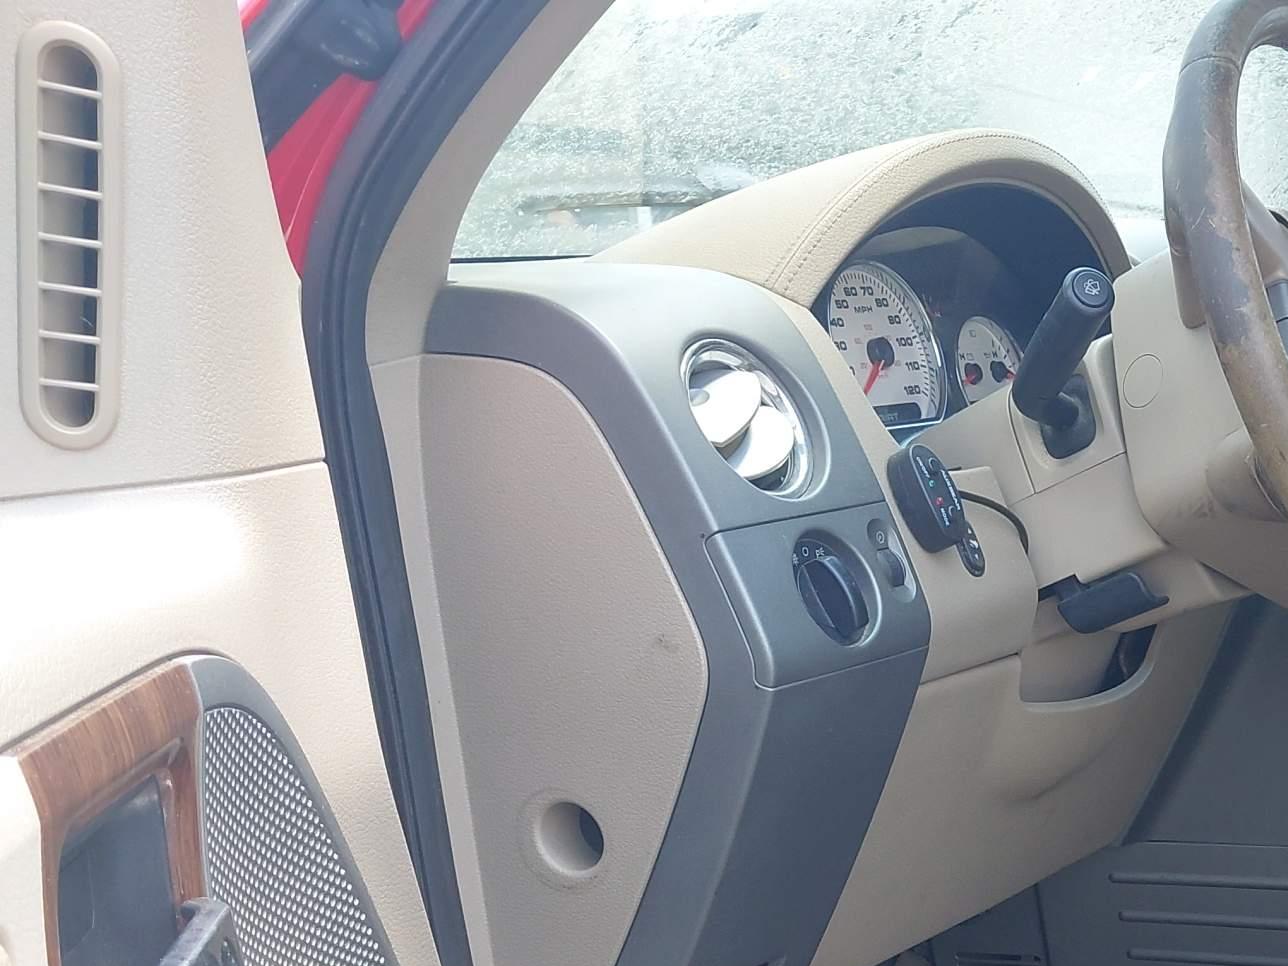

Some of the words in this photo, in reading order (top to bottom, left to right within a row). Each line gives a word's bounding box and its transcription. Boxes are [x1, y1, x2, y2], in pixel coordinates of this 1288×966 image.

[843, 286, 858, 297] 60
[860, 286, 874, 297] 70
[835, 299, 849, 309] 50
[875, 298, 889, 308] 80
[854, 305, 873, 313] MPH
[830, 317, 845, 328] 40
[896, 337, 913, 347] 100
[905, 361, 920, 371] 110
[903, 384, 921, 395] 120
[941, 507, 950, 526] MODE
